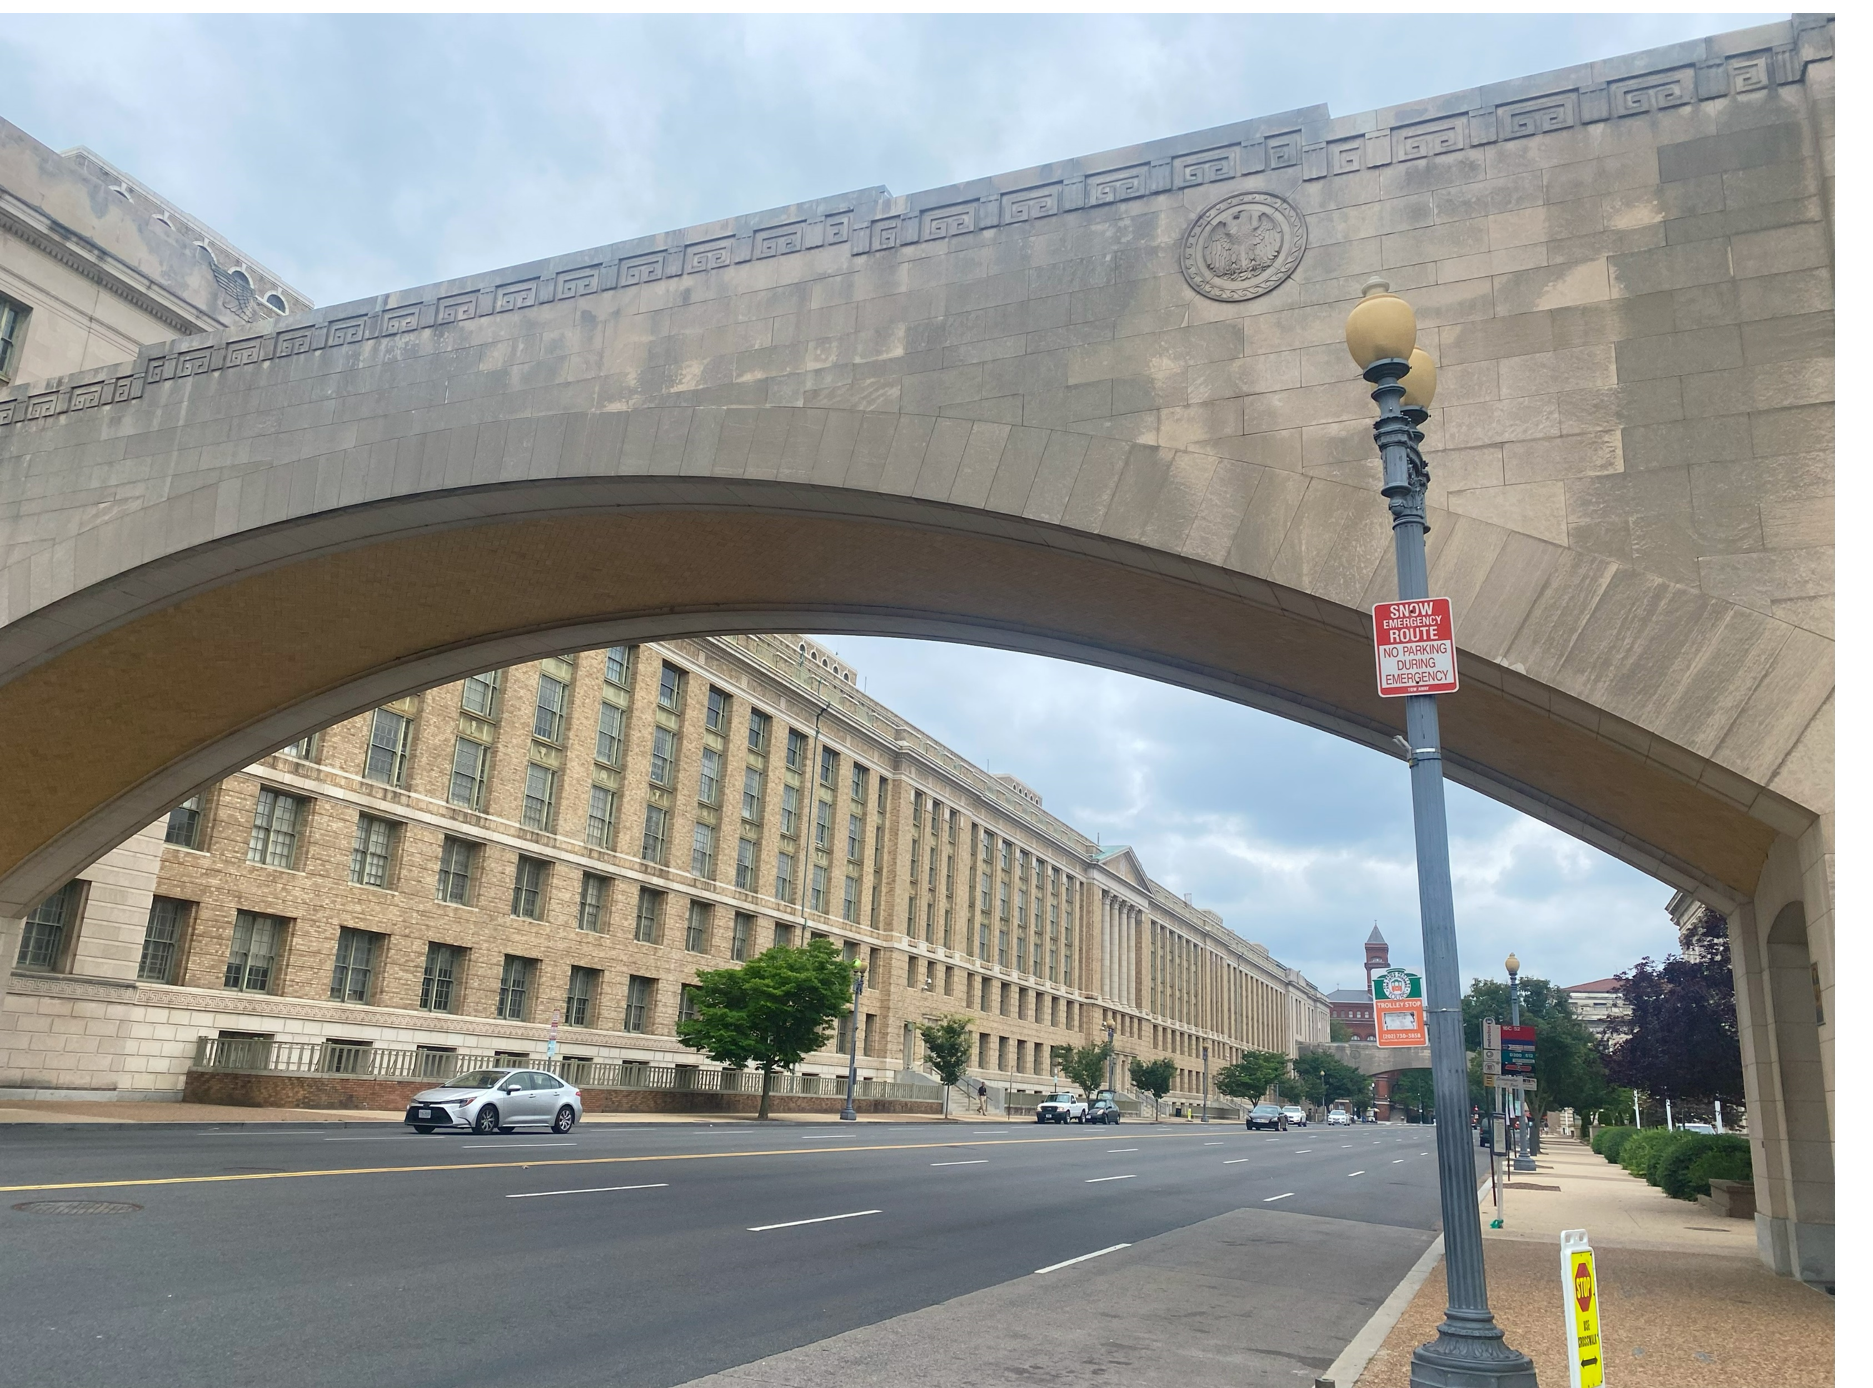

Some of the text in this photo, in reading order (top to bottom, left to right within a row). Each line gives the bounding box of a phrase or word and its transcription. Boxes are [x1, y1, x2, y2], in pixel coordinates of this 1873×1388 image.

[1390, 602, 1433, 618] SNOW
[1383, 615, 1442, 629] EMERGENCY
[1389, 626, 1438, 643] ROUTE
[1383, 643, 1447, 658] NO PARKING
[1397, 657, 1436, 671] DURING
[1386, 670, 1448, 685] EMERGENCY
[1576, 1276, 1591, 1299] STOP
